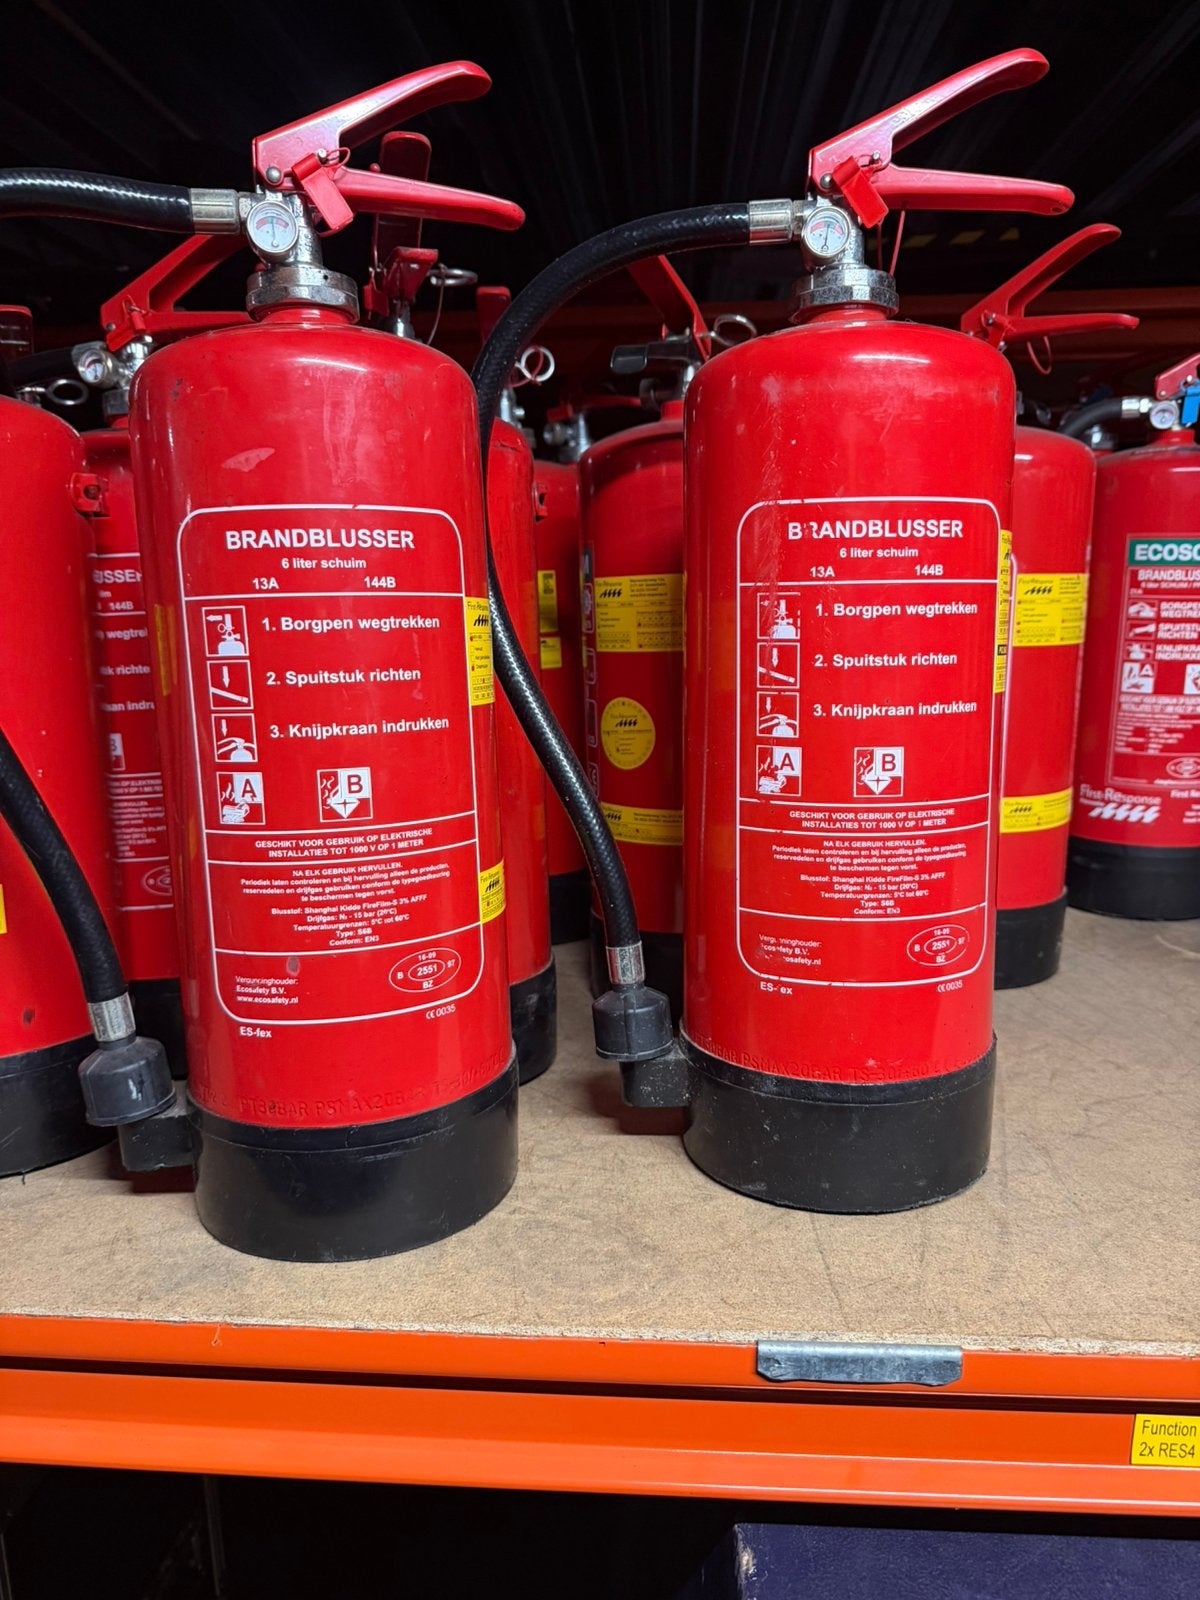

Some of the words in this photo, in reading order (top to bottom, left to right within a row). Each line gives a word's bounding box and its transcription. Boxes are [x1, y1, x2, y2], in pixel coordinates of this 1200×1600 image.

[788, 520, 963, 540] BRANDBLUSSER
[226, 529, 414, 550] BRANDBLUSSER
[840, 548, 847, 558] 6
[850, 548, 873, 558] liter
[876, 548, 918, 557] schuim
[281, 558, 290, 568] 6
[292, 558, 317, 568] liter
[321, 558, 366, 568] schuim
[810, 566, 835, 578] 13A
[914, 565, 943, 576] 144B
[252, 578, 279, 590] 13A
[364, 576, 396, 588] 144B
[815, 604, 829, 616] 1.
[833, 604, 901, 620] Borgpen
[906, 602, 978, 617] wegtrekken
[262, 617, 276, 632] 1.
[281, 617, 353, 633] Borgpen
[357, 616, 440, 631] wegtrekken
[814, 655, 828, 667] 2.
[833, 654, 907, 668] Spuitstuk
[912, 653, 958, 666] richten
[116, 664, 150, 676] richte
[266, 672, 280, 686] 2.
[286, 670, 365, 687] Spuitstuk
[369, 670, 420, 682] richten
[813, 704, 826, 717] 3.
[831, 704, 914, 720] Knijpkraan
[918, 700, 977, 714] indrukken
[270, 724, 284, 738] 3.
[288, 720, 378, 740] Knijpkraan
[382, 716, 450, 734] indrukken
[780, 752, 796, 772] A
[882, 753, 896, 772] B
[241, 778, 257, 799] A
[346, 774, 363, 794] B
[789, 810, 830, 820] GESCHIKT
[832, 811, 856, 820] VOOR
[858, 811, 894, 820] GEBRUIK
[896, 810, 906, 818] OP
[908, 808, 954, 818] ELEKTRISCHE
[802, 820, 858, 829] INSTALLATIES
[860, 820, 876, 828] TOT
[878, 820, 896, 828] 1000
[897, 820, 902, 828] V
[905, 820, 916, 828] OP
[922, 818, 946, 827] METER
[255, 840, 296, 848] GESCHIKT
[298, 838, 323, 848] VOOR
[325, 836, 364, 846] GEBRUIK
[366, 834, 378, 842] OP
[380, 827, 432, 841] ELEKTRISCHE
[268, 848, 328, 858] INSTALLATIES
[330, 847, 347, 856] TOT
[349, 846, 368, 854] 1000
[370, 844, 376, 852] V
[377, 844, 389, 852] OP
[398, 838, 424, 850] METER
[322, 866, 356, 876] GEBRUIK
[358, 862, 403, 872] HERVULLEN.
[820, 891, 892, 900] Temperatuurgrenzen:
[304, 906, 338, 914] Shanghai
[293, 920, 370, 932] Temperatuurgrenzen:
[330, 938, 363, 946] Conform:
[417, 964, 438, 976] 2551
[271, 986, 286, 994] B.V.
[422, 980, 434, 989] BZ
[237, 996, 298, 1004] www.ecosafety.nl
[436, 1004, 456, 1016] 0035
[240, 1026, 272, 1038] ES-fex
[1142, 1419, 1197, 1437] Function
[1138, 1442, 1154, 1457] 2x
[1158, 1442, 1196, 1458] RES4
